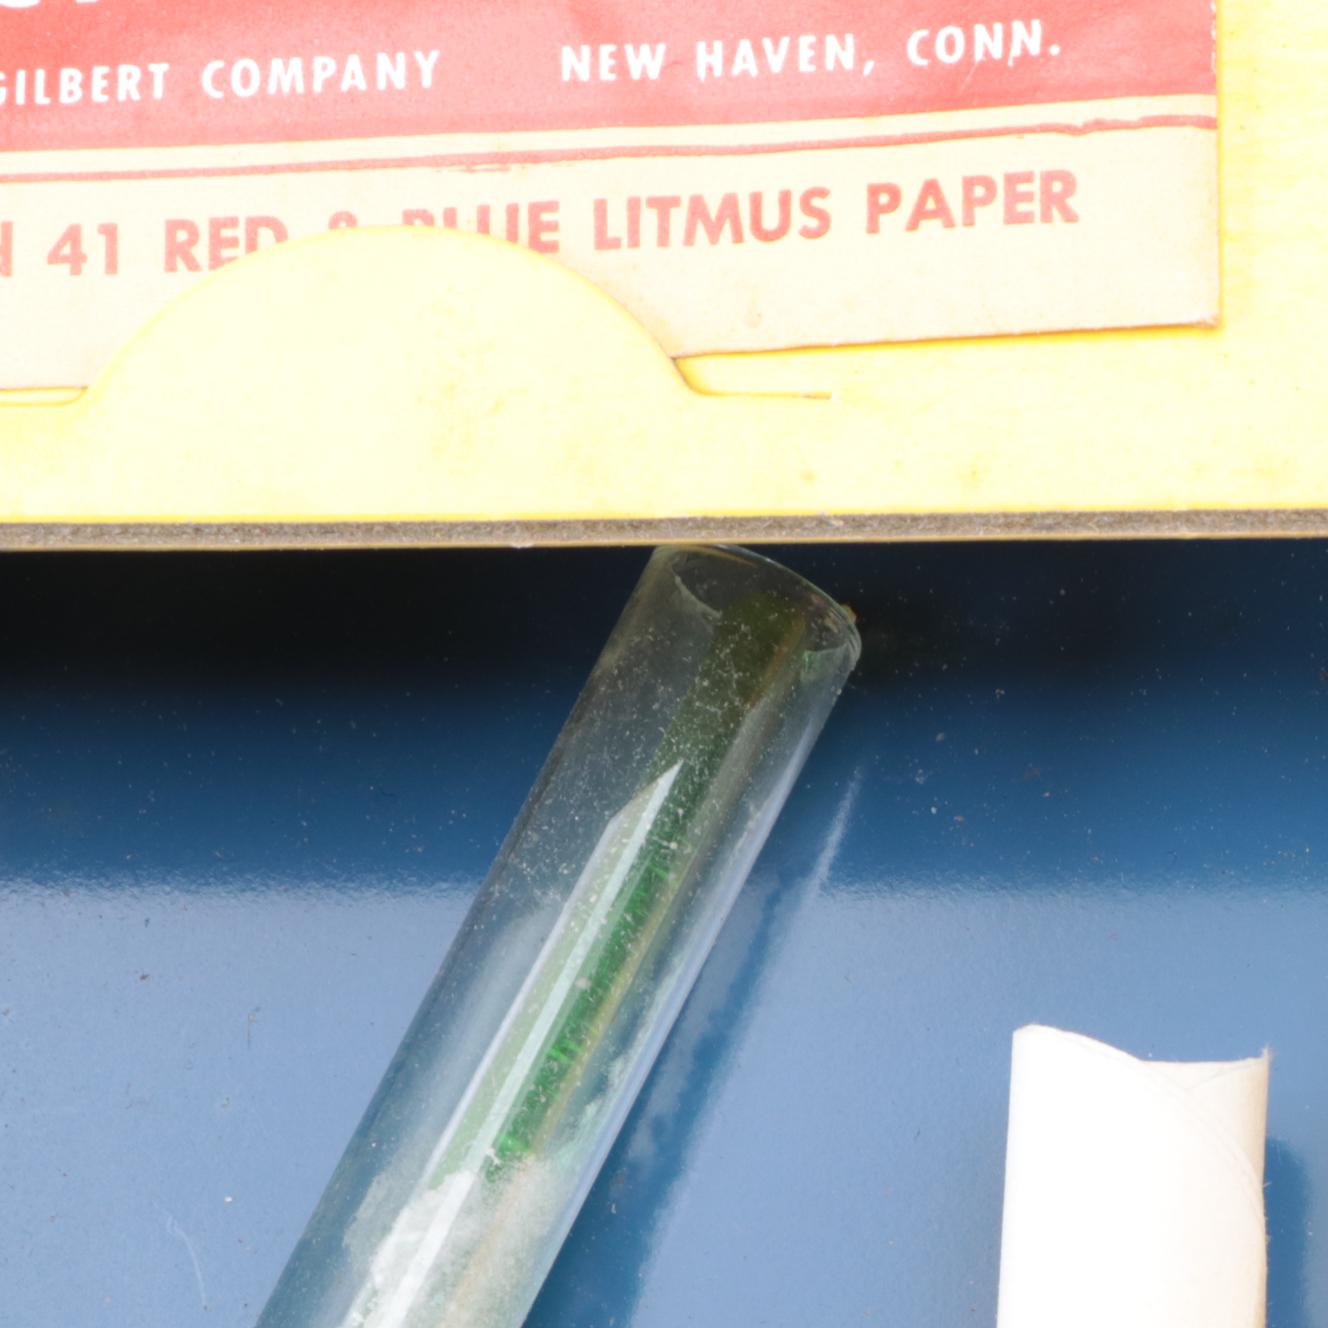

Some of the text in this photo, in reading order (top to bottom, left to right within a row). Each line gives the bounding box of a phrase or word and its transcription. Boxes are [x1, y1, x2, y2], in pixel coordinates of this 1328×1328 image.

[201, 49, 441, 99] COMPANY
[560, 19, 1061, 82] NEW HAVEN, CONN.
[46, 222, 119, 277] 41
[163, 215, 289, 273] RED
[592, 187, 831, 251] LITMUS
[865, 169, 1079, 234] PAPER
